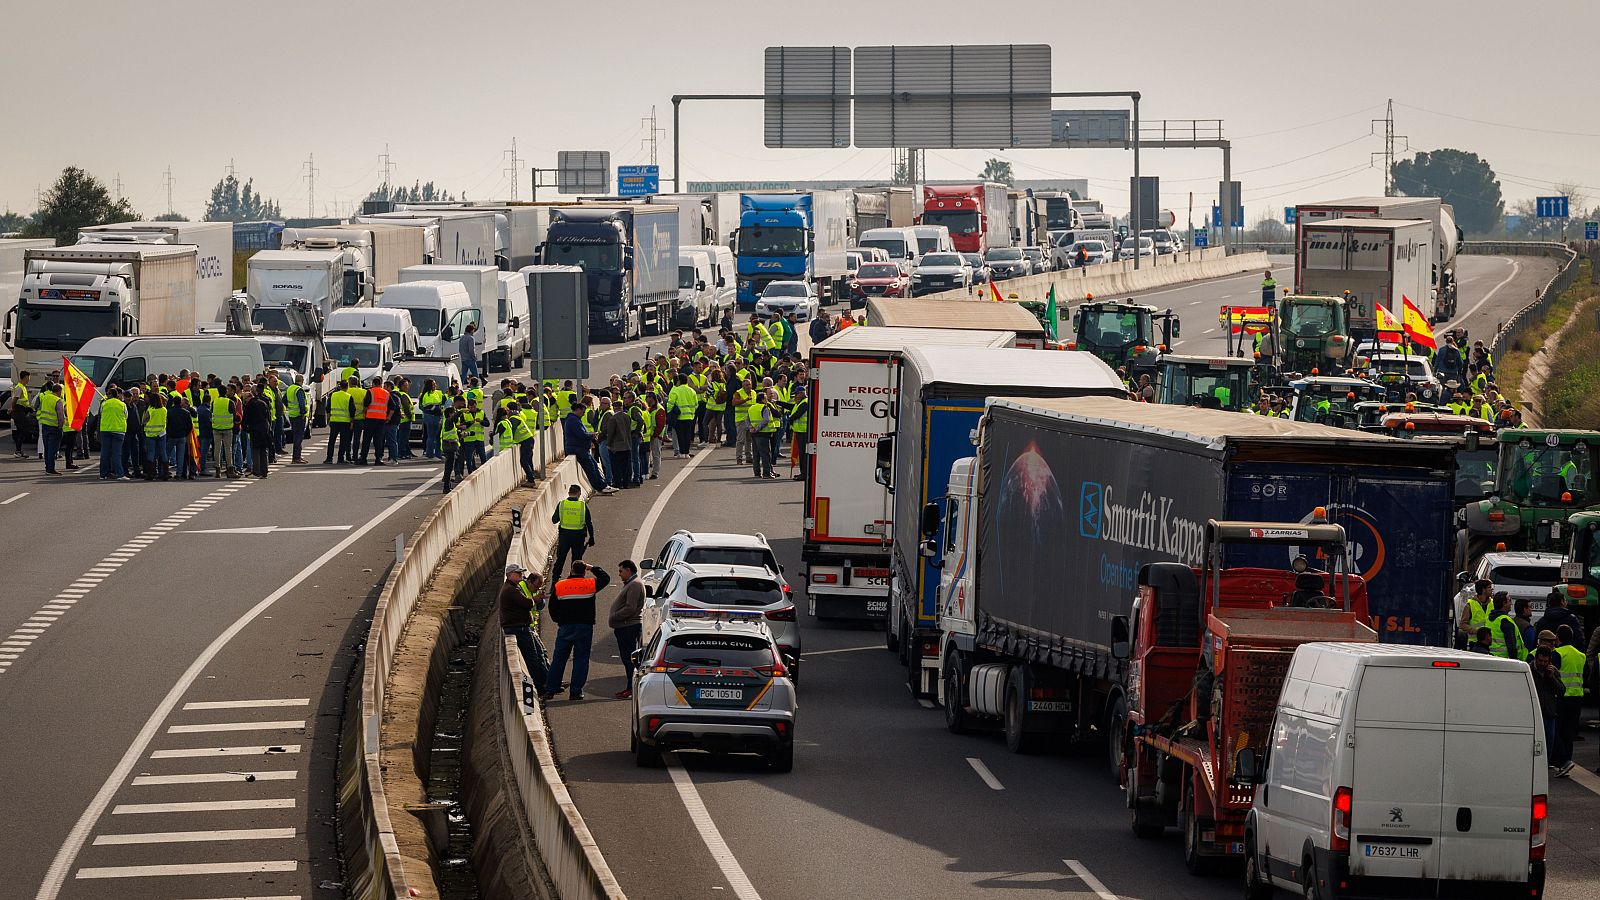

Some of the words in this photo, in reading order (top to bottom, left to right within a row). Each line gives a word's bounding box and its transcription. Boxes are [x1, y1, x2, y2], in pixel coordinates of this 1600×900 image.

[829, 440, 877, 448] CALATAYU
[1547, 434, 1558, 446] 40
[1102, 484, 1157, 551] Smurfit
[1157, 496, 1205, 565] Kappa
[1387, 615, 1420, 632] S.L.
[700, 689, 715, 698] PGC
[716, 690, 734, 699] 1051
[1371, 845, 1397, 857] 7637
[1399, 847, 1419, 858] LHR
